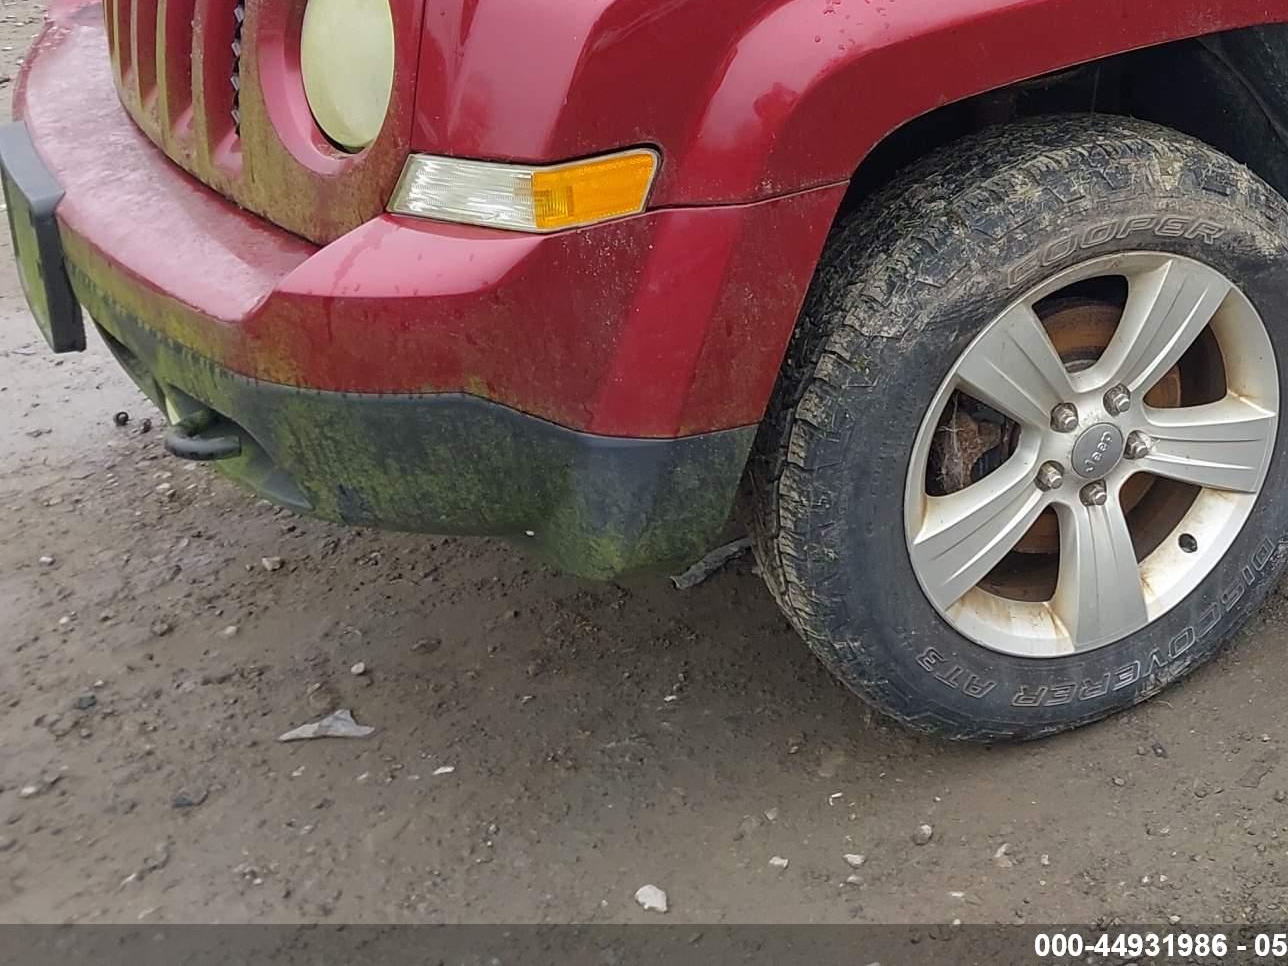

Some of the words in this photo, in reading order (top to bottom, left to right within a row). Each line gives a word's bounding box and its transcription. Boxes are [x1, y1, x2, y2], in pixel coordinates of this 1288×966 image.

[1006, 213, 1226, 290] COOPER
[1012, 537, 1277, 707] DISCOVERER
[914, 645, 998, 700] AT3
